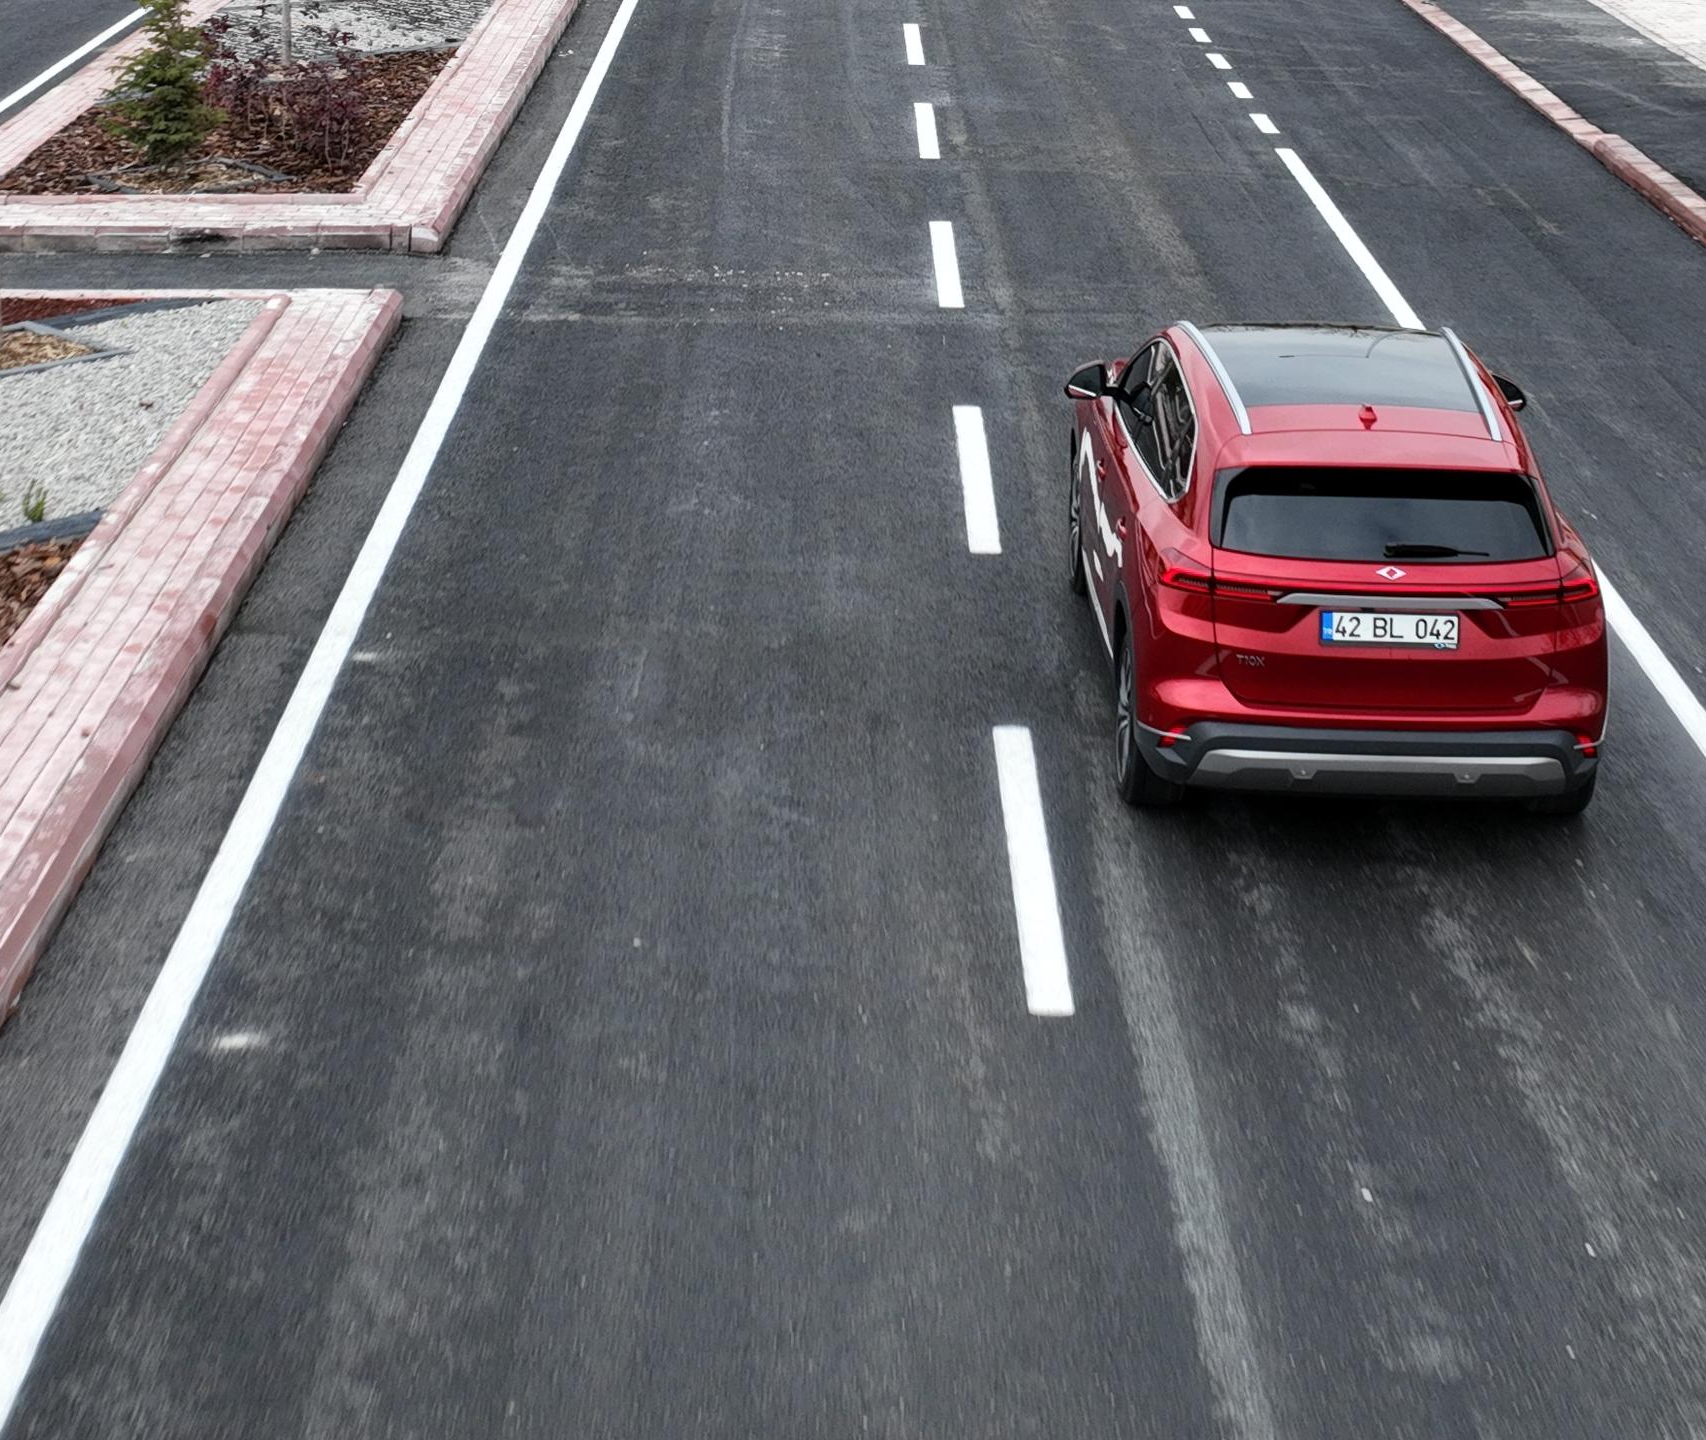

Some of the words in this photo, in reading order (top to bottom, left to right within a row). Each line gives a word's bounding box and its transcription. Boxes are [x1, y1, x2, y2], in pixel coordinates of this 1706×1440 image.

[1335, 616, 1361, 638] 42
[1373, 617, 1404, 639] BL
[1415, 618, 1455, 641] 042
